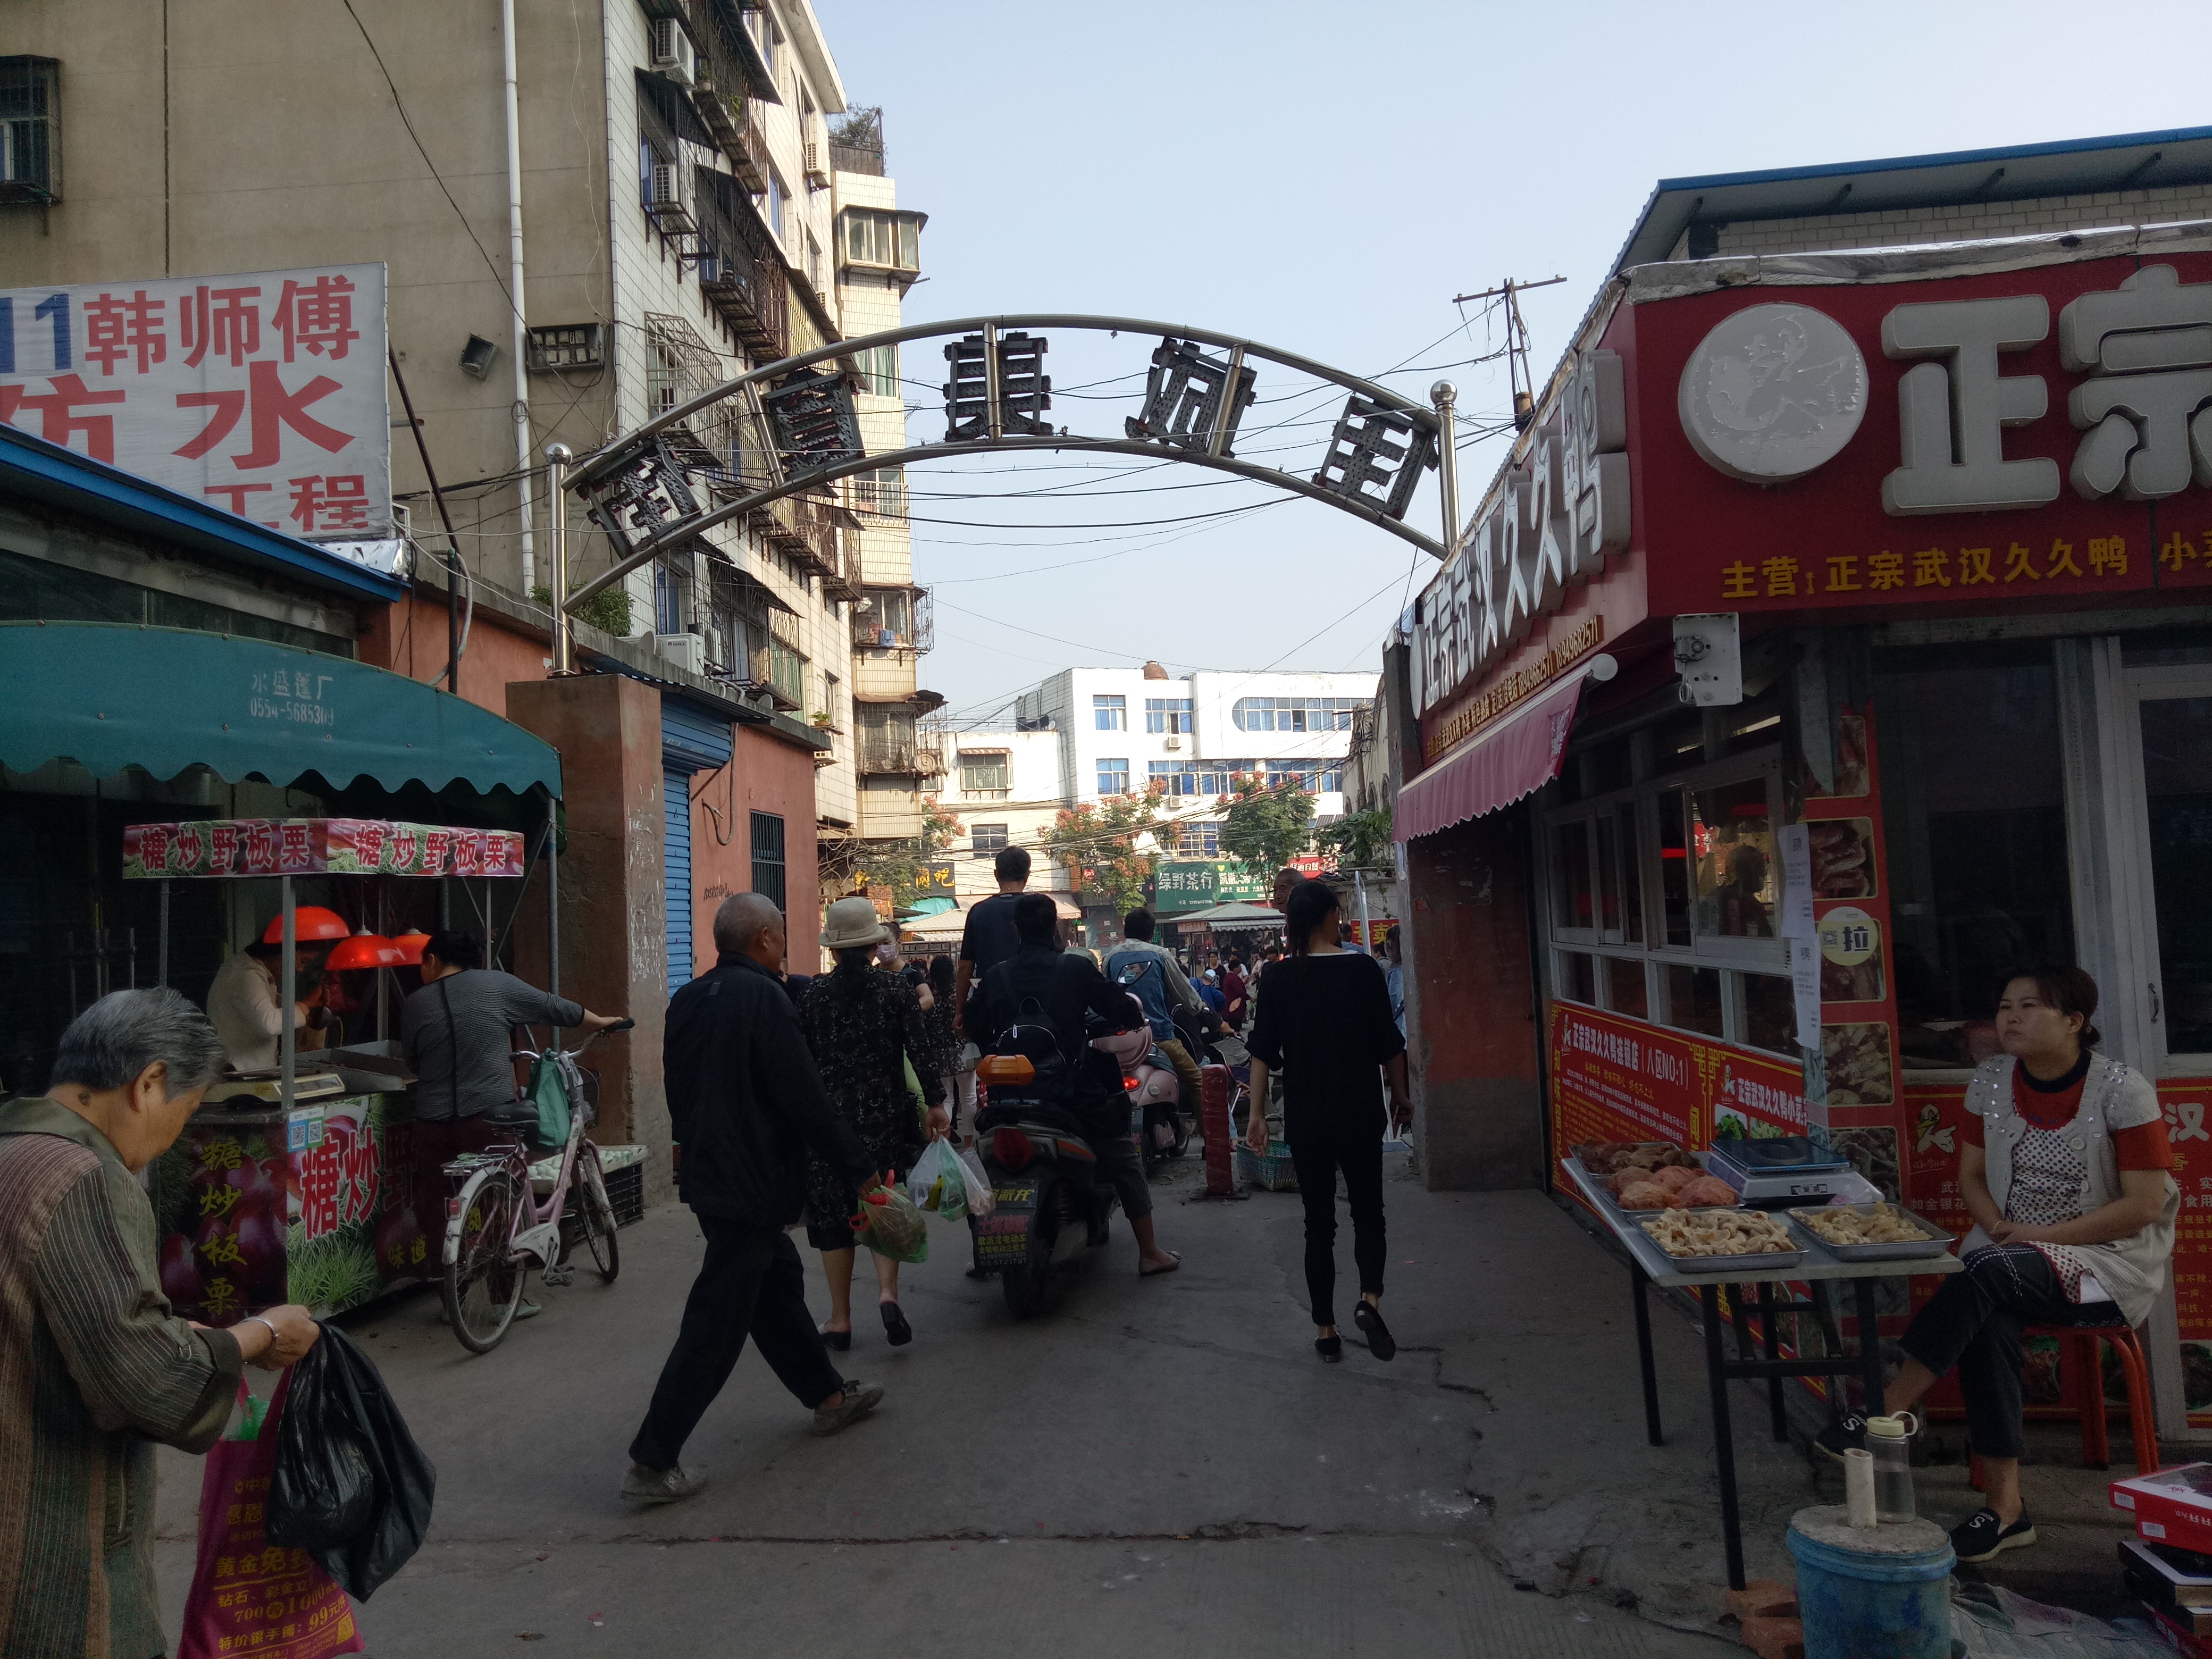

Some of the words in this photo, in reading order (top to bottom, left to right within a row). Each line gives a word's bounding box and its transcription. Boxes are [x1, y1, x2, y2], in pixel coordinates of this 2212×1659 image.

[83, 275, 360, 376] 韩师傅
[1881, 264, 2212, 516] 正宗
[2160, 532, 2212, 572] 小
[140, 824, 314, 871] 糖炒野板栗
[355, 824, 507, 871] 糖炒野板栗
[2164, 1102, 2210, 1143] 汉
[198, 1138, 248, 1317] 糖炒板栗
[1842, 1417, 1861, 1431] S
[1968, 1516, 1986, 1529] S
